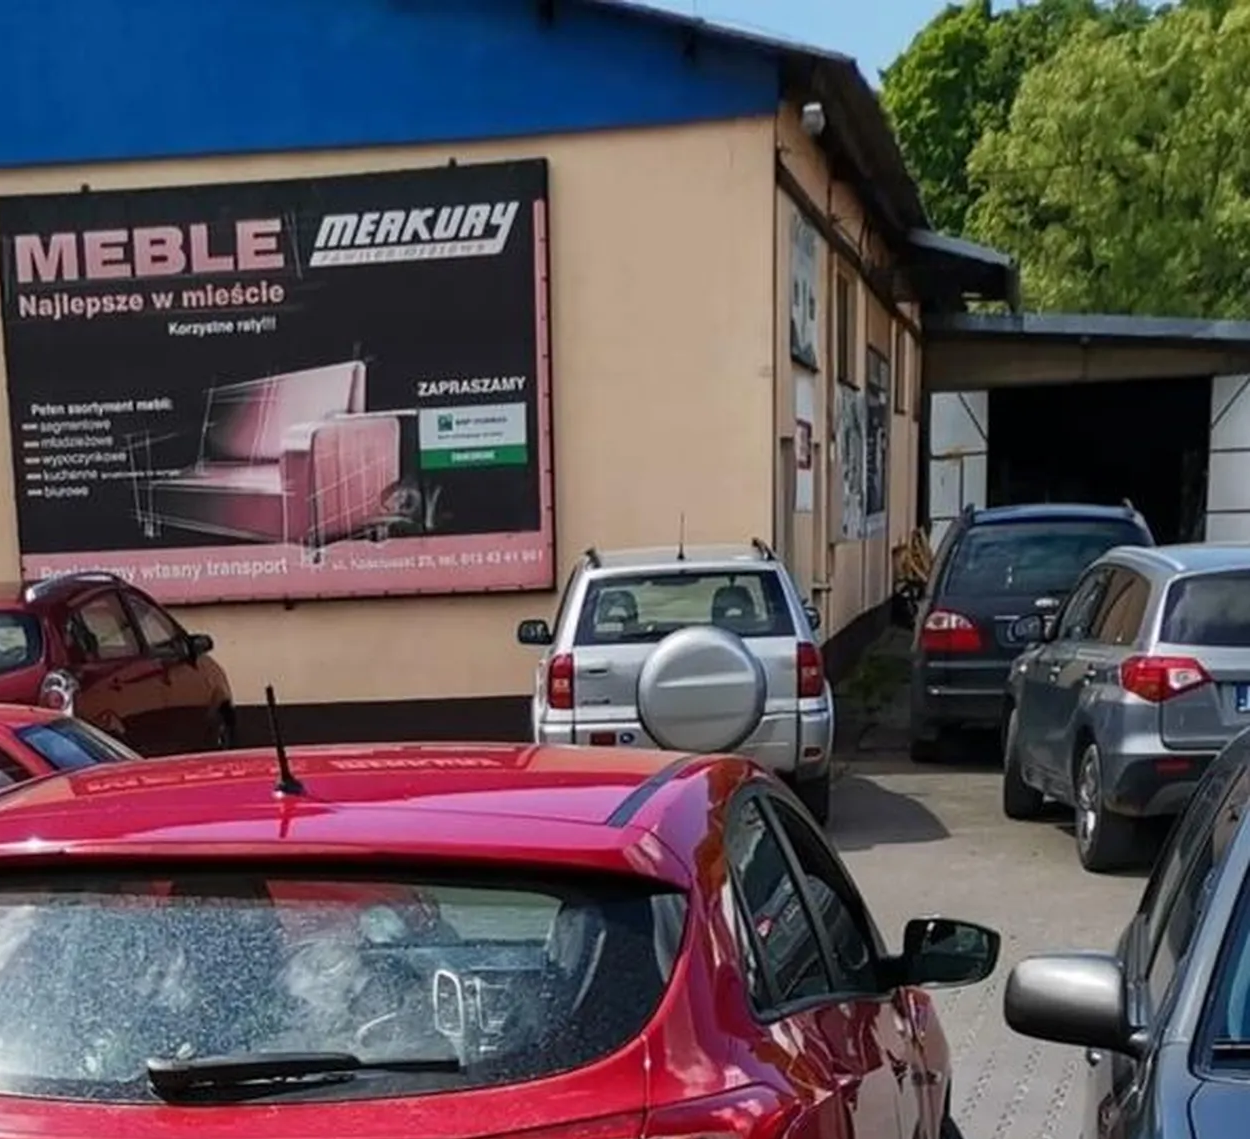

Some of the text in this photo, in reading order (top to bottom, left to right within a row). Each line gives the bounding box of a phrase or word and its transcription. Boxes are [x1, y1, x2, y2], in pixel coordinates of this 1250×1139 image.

[313, 201, 519, 252] MERKURY
[15, 219, 284, 282] MEBLE
[19, 280, 285, 320] Najlepsze w mieście
[418, 376, 526, 397] ZAPRASZAMY
[207, 557, 288, 579] transport
